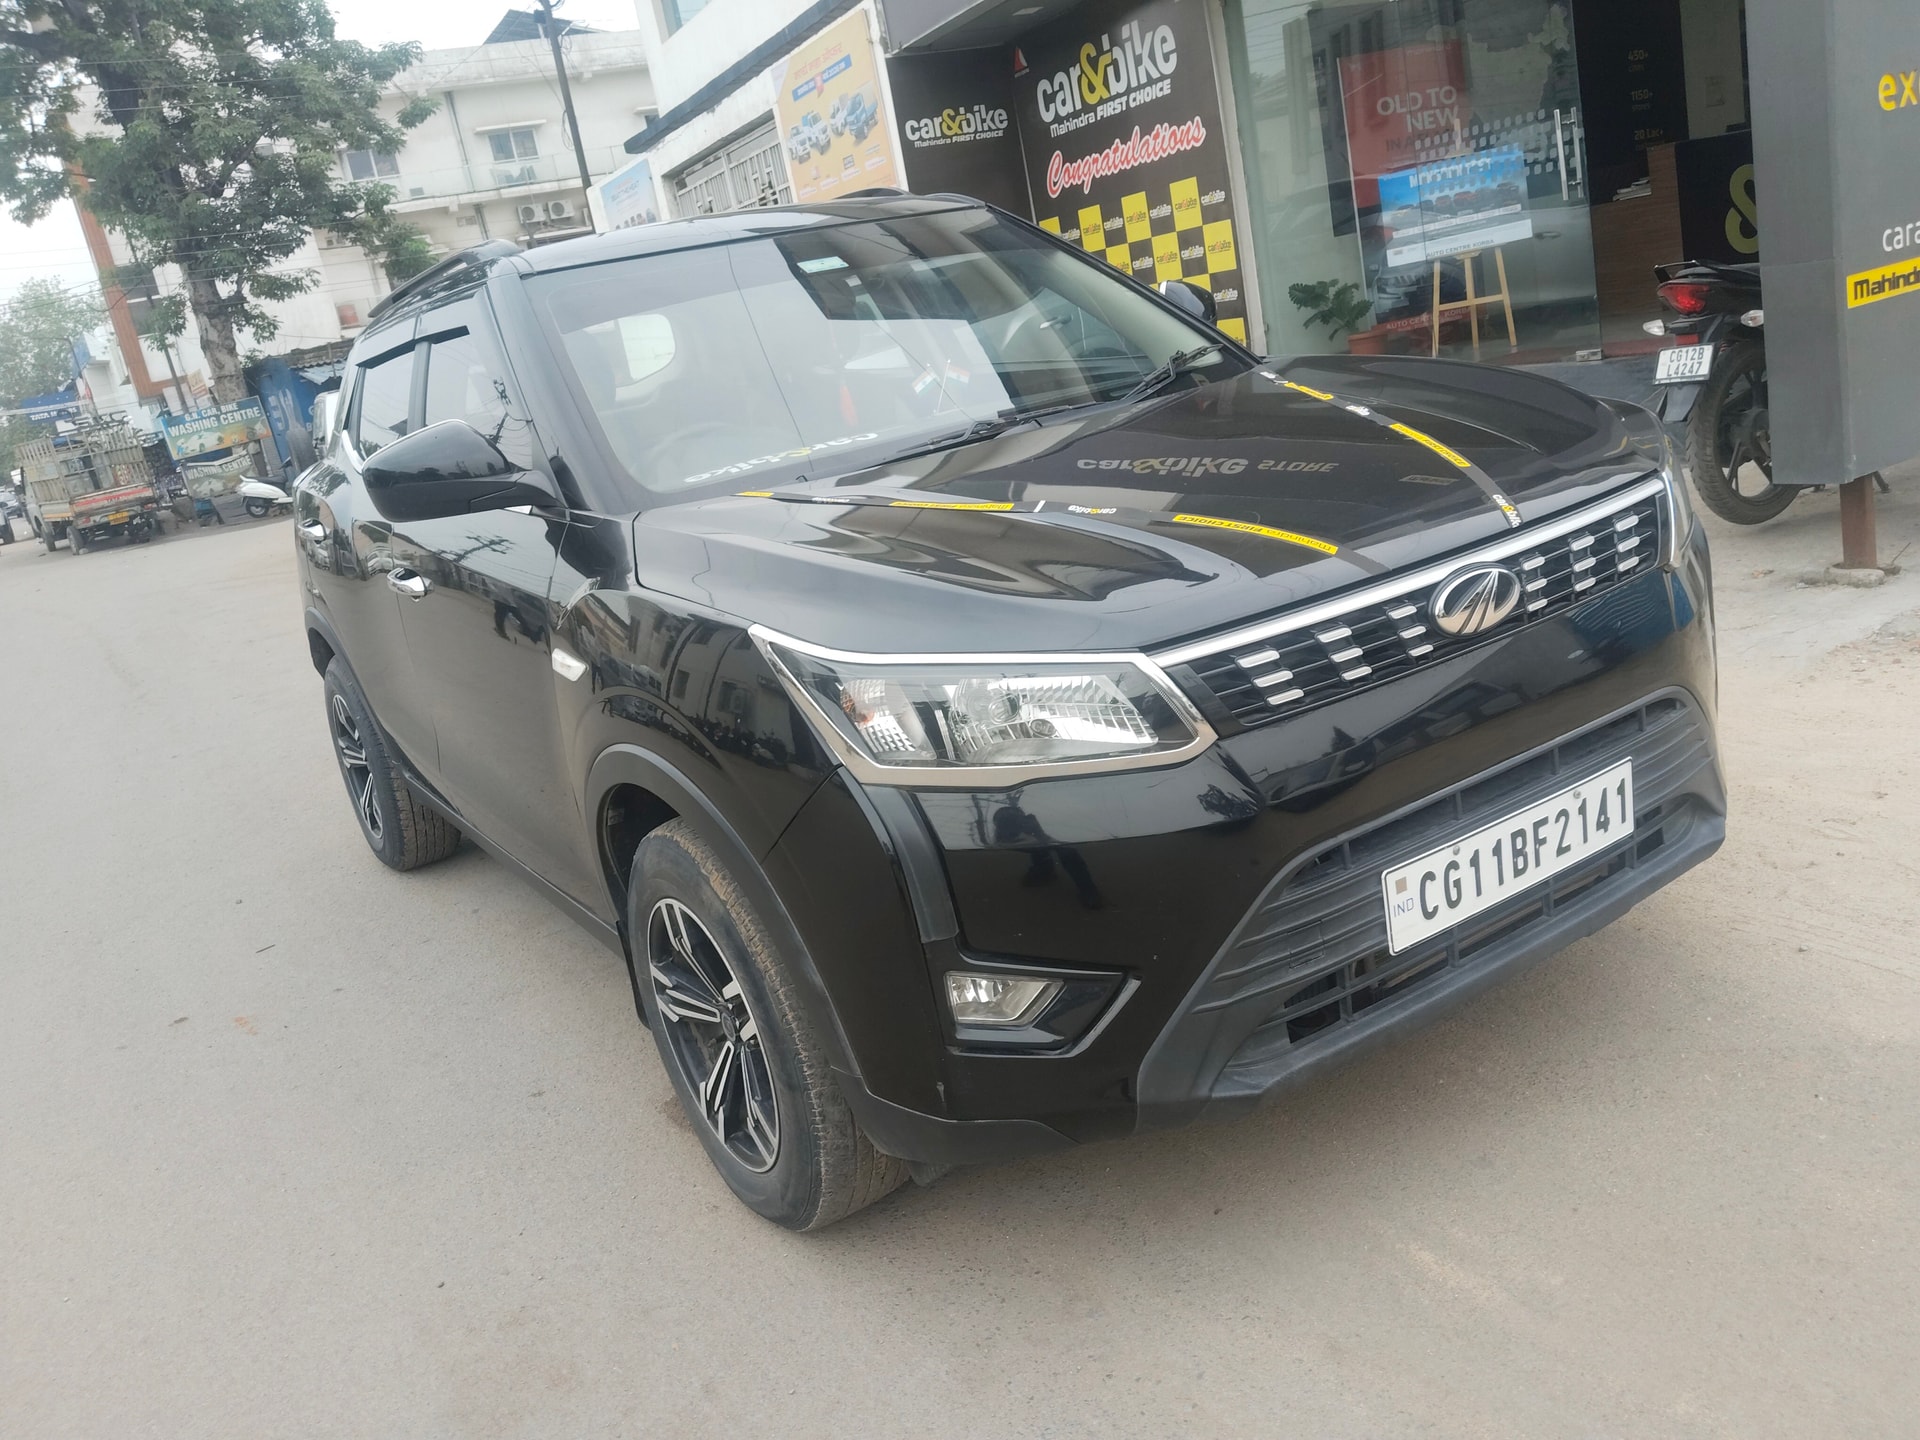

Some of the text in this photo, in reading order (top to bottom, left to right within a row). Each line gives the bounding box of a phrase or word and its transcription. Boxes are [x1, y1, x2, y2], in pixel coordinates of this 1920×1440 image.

[1037, 20, 1178, 123] car&bike
[1376, 86, 1457, 116] OLD TO
[1878, 70, 1920, 112] ex
[1051, 78, 1171, 138] Mahindra FIRST CHOICE
[1406, 105, 1459, 133] NEW
[905, 105, 1008, 141] car&bike
[914, 130, 1004, 148] Mahindra FIRST CHOICE
[1047, 116, 1206, 198] Congratulations
[1667, 361, 1703, 377] L4247
[1670, 347, 1705, 363] CG12B
[168, 418, 218, 437] WASHING
[221, 406, 262, 425] CENTRE
[220, 402, 239, 413] BIKE
[222, 455, 252, 473] CENTRE
[1180, 515, 1223, 527] CHOICE
[1225, 522, 1262, 533] FIRST
[1419, 777, 1627, 921] CG11BF2141
[1393, 897, 1414, 918] IND
